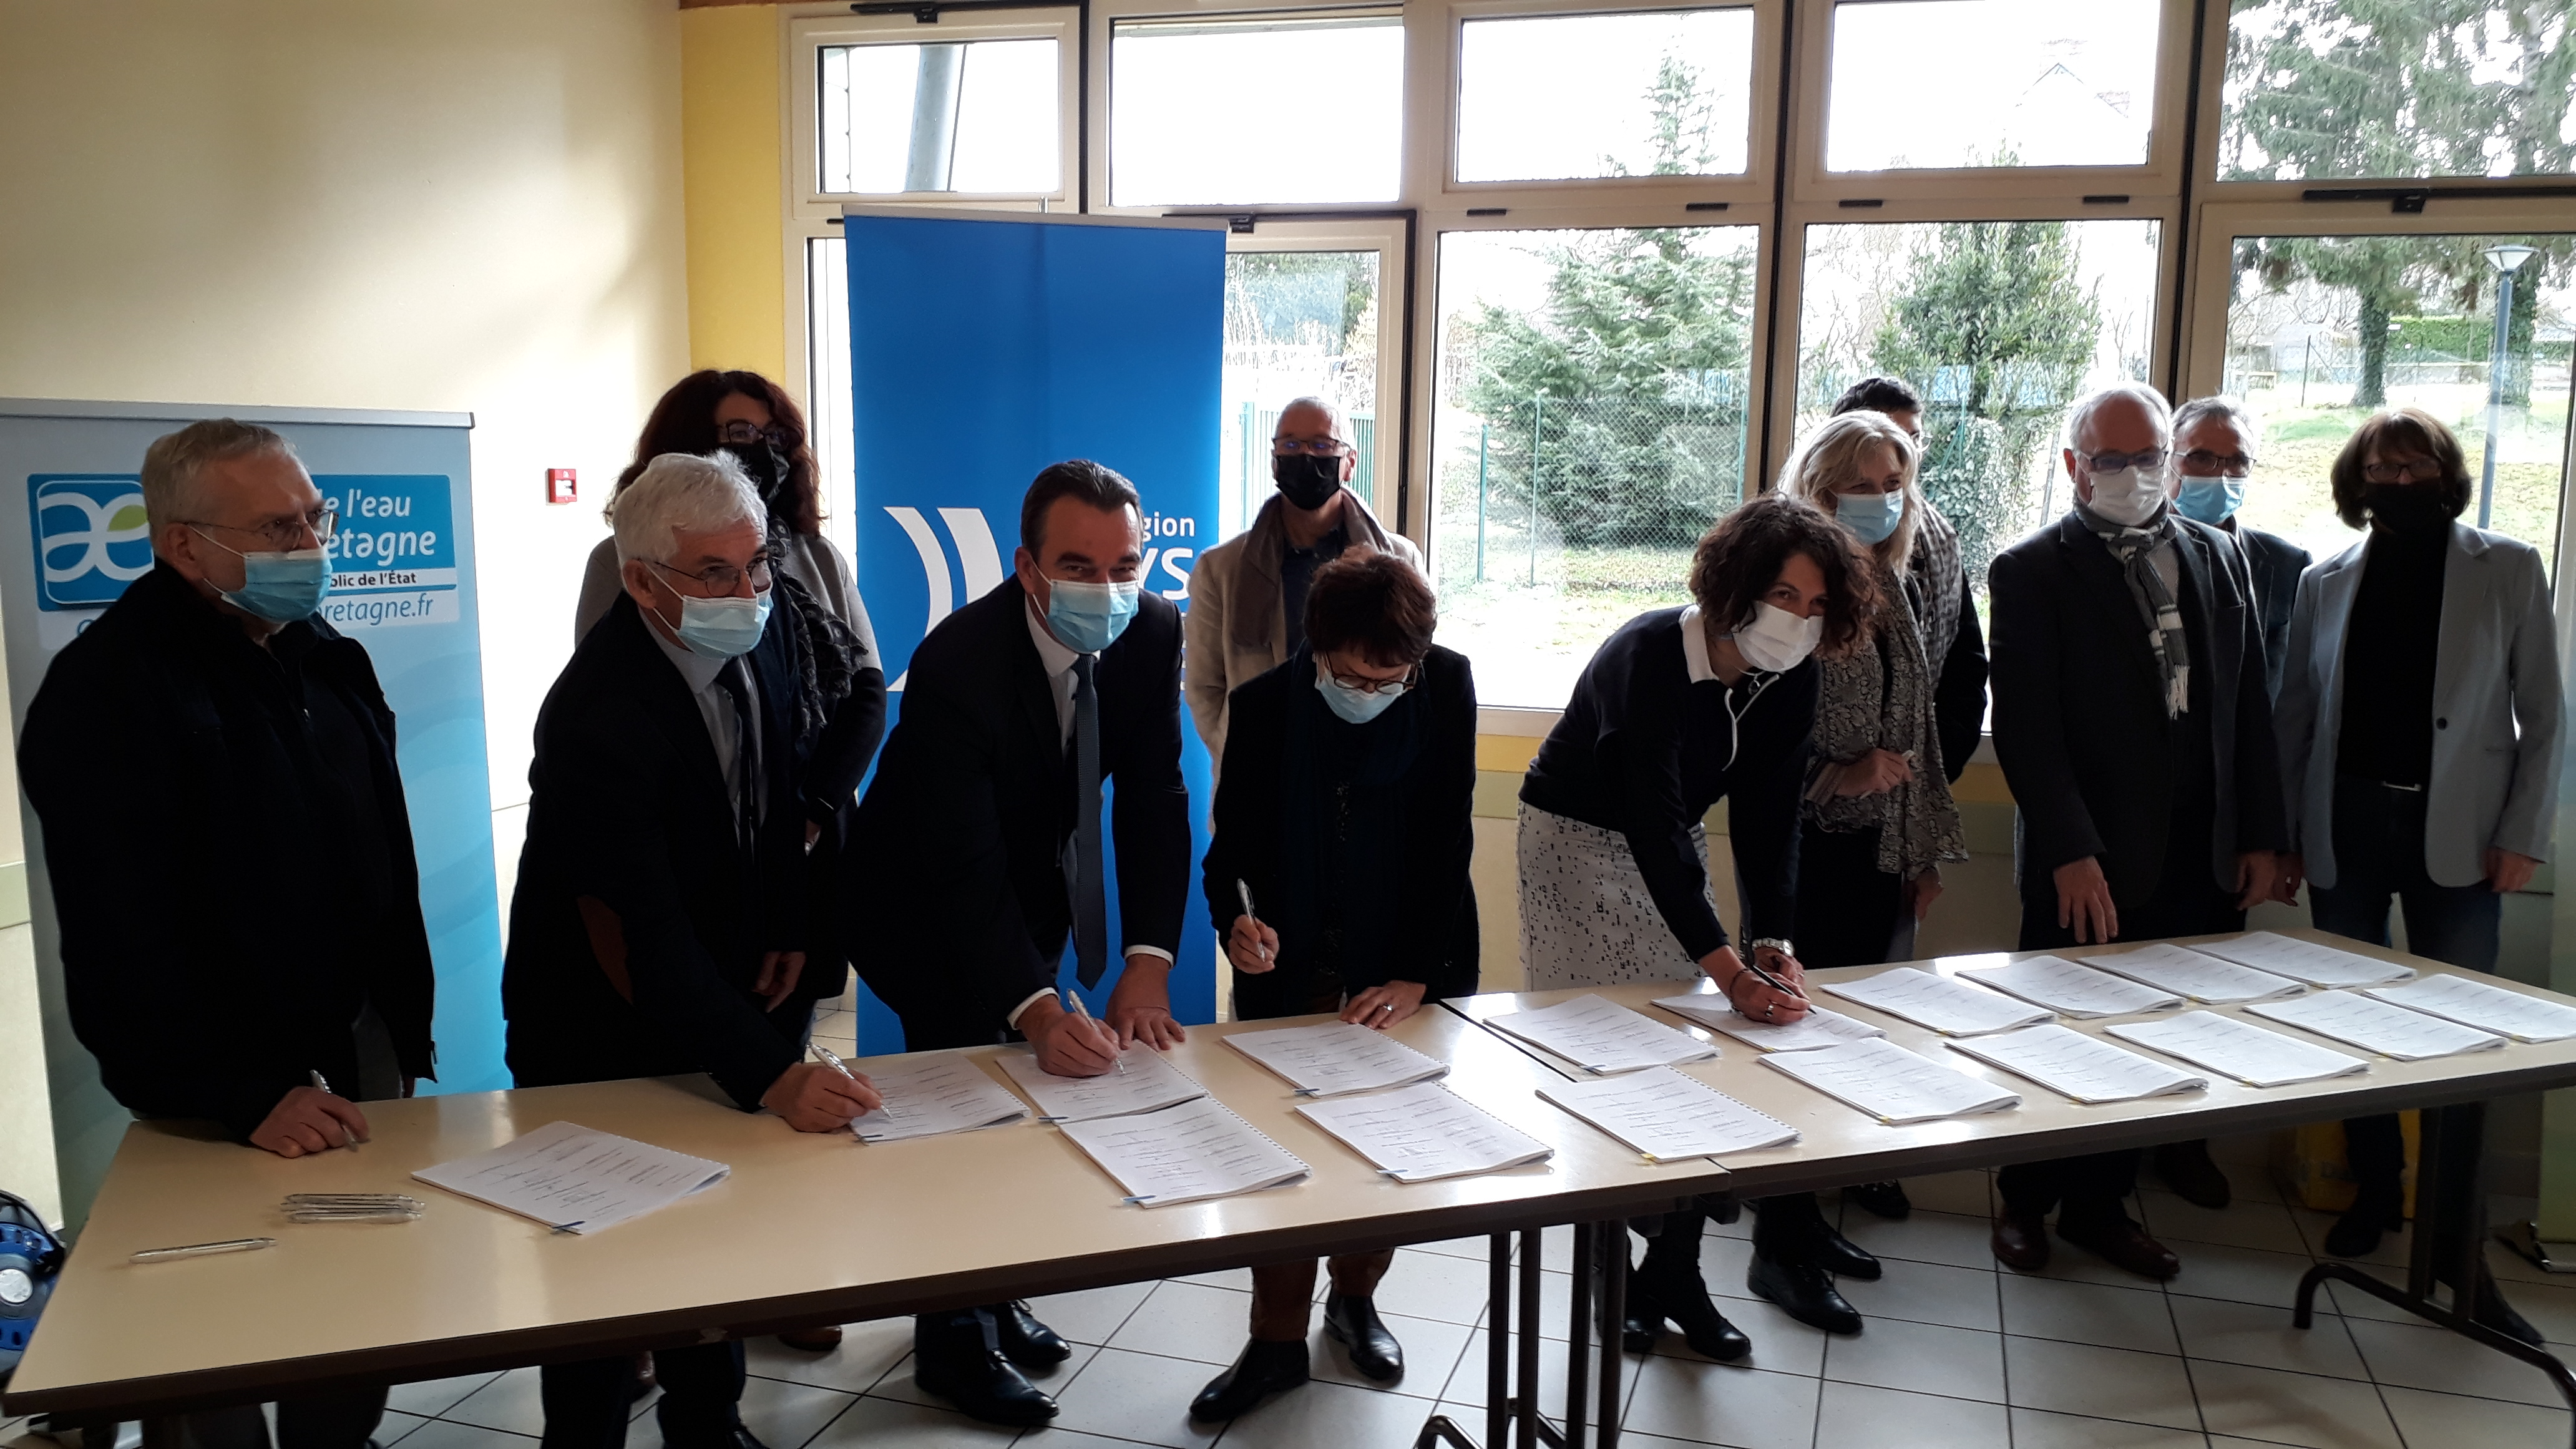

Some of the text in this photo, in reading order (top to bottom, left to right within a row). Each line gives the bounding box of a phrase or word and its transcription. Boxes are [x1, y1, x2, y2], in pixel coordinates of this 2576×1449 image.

[346, 488, 411, 518] l'eau
[358, 573, 376, 586] de
[379, 569, 417, 585] l'État
